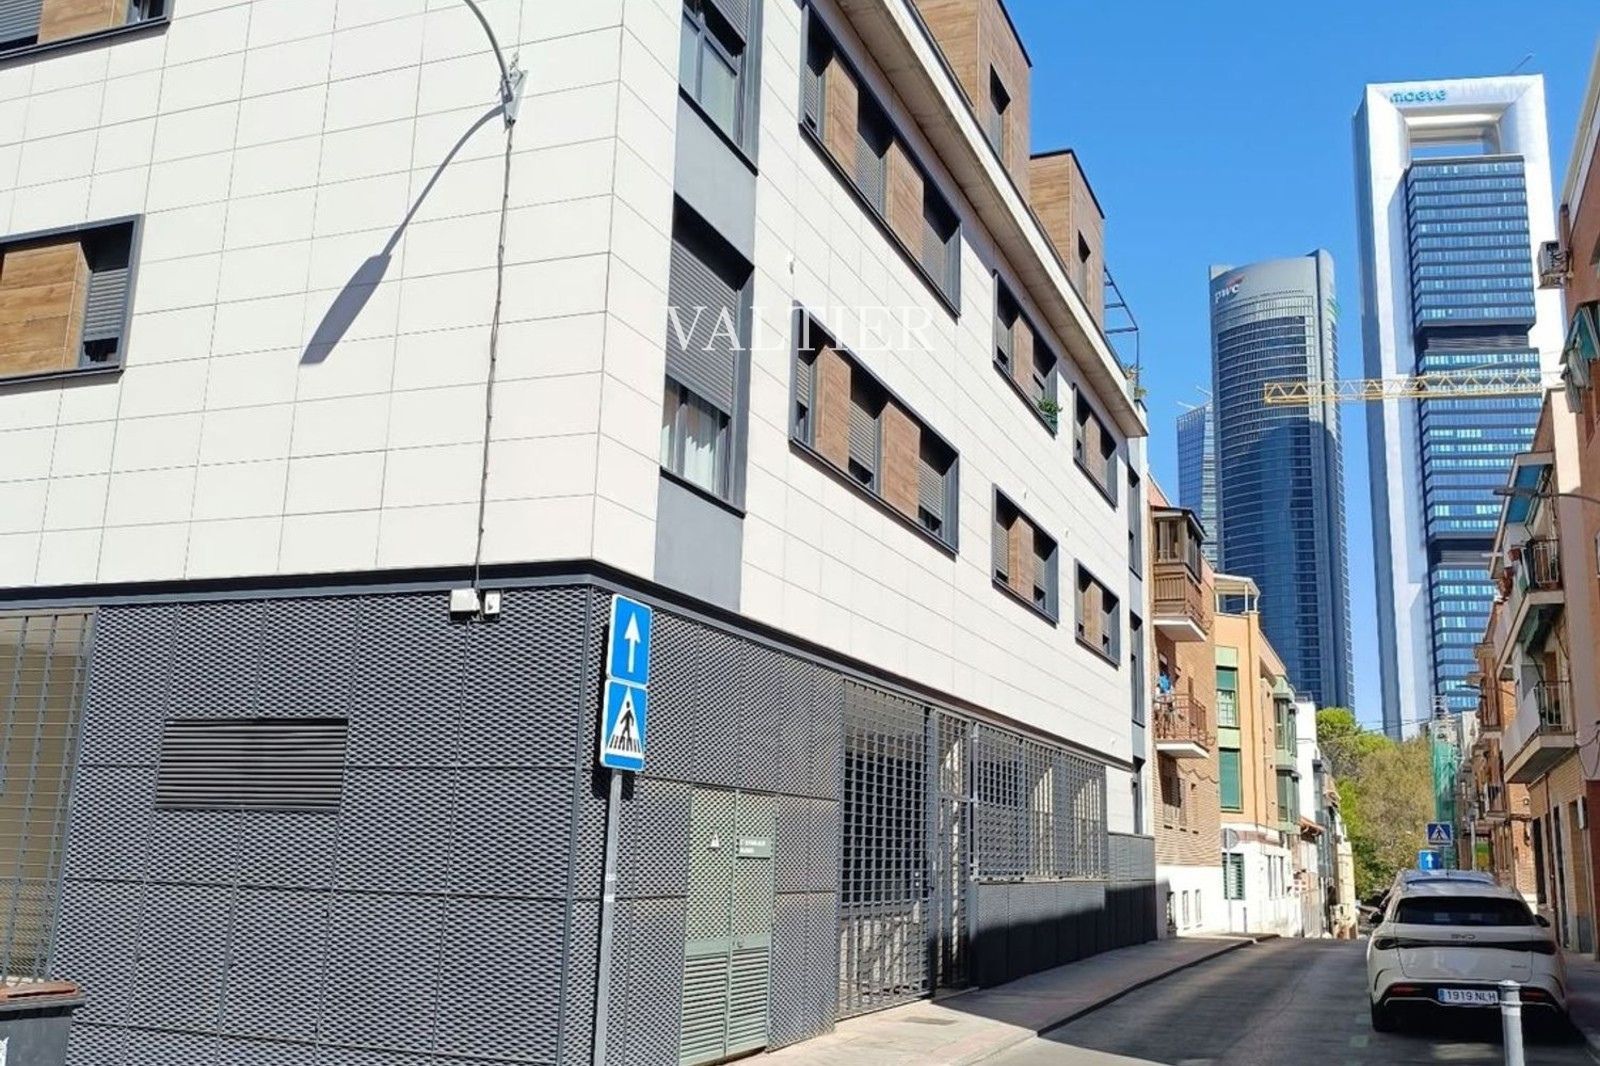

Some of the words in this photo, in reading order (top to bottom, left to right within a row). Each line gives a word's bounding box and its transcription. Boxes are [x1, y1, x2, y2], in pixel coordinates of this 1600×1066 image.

[1389, 89, 1447, 103] moeve
[1447, 990, 1472, 1000] 1919
[1475, 991, 1497, 1002] NLH
